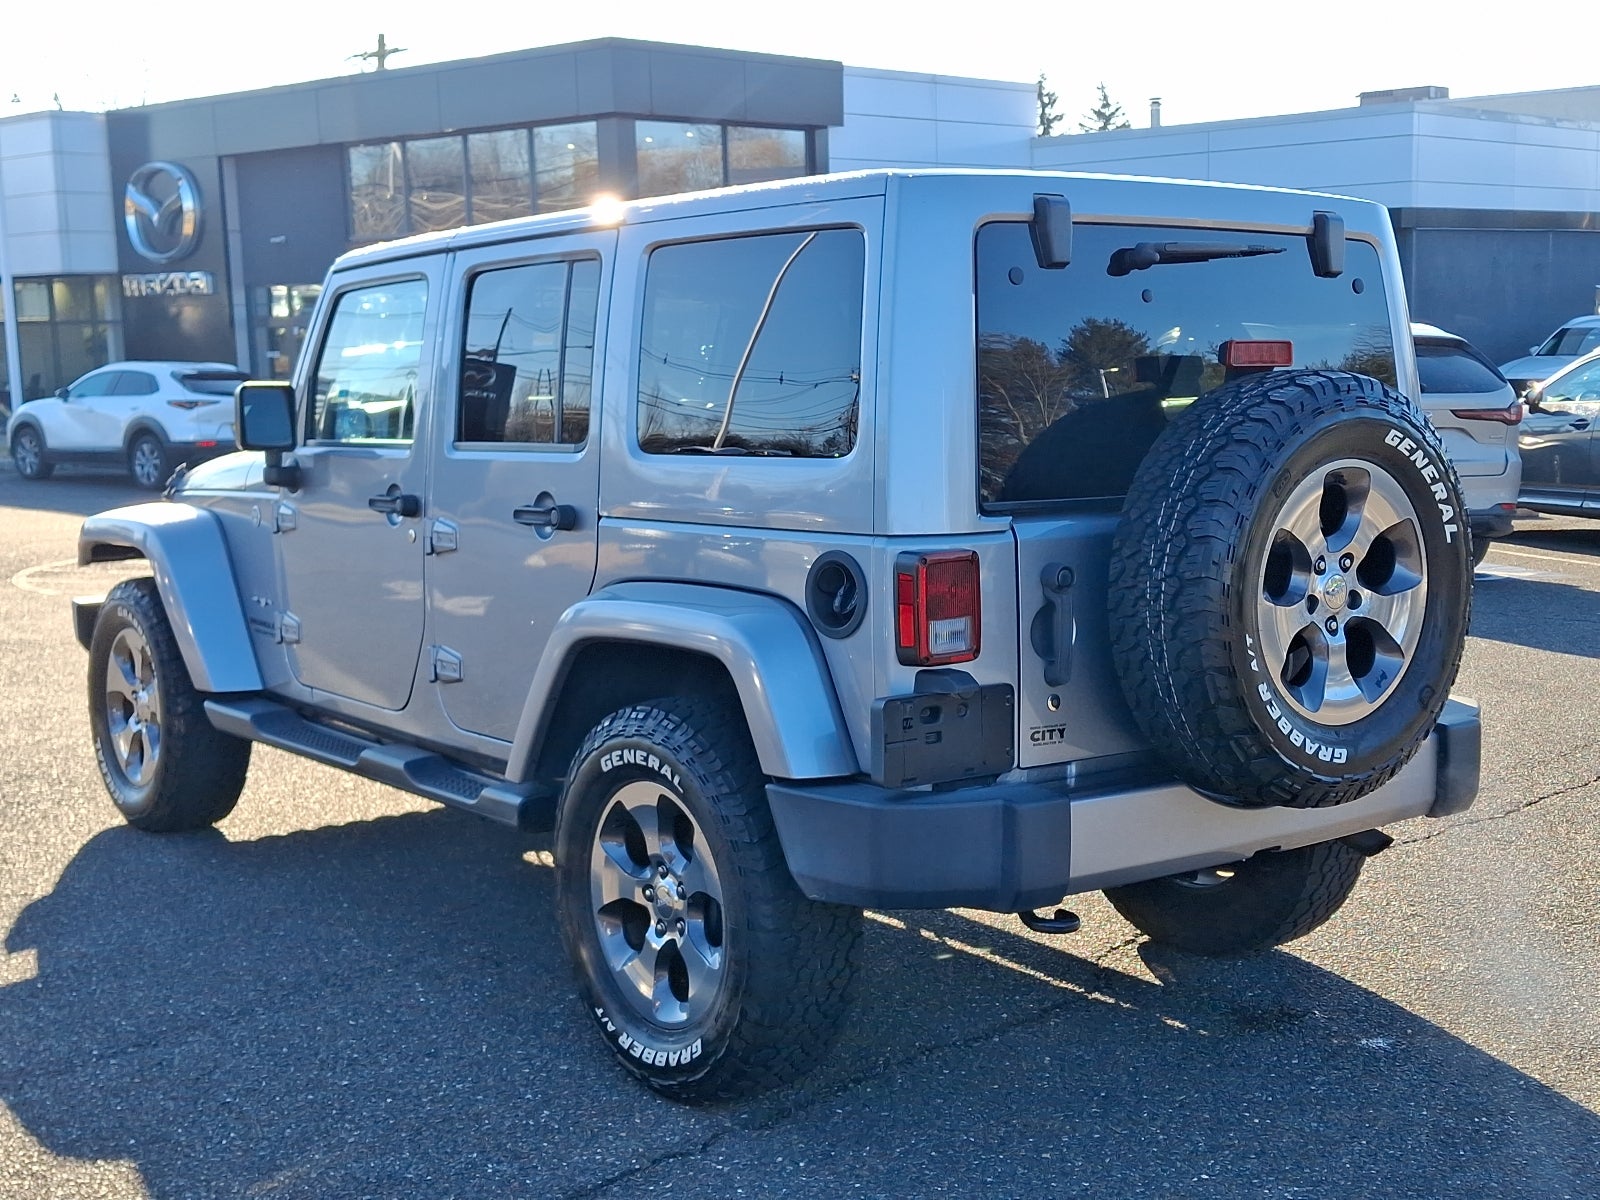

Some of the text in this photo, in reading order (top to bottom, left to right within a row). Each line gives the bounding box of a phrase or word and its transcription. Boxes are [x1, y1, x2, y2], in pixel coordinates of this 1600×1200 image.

[1384, 428, 1458, 544] GENERAL
[1246, 633, 1348, 764] GRABBER A/T
[1030, 728, 1066, 742] CITY
[600, 748, 684, 794] GENERAL
[595, 1007, 702, 1067] GRABBER A/T
